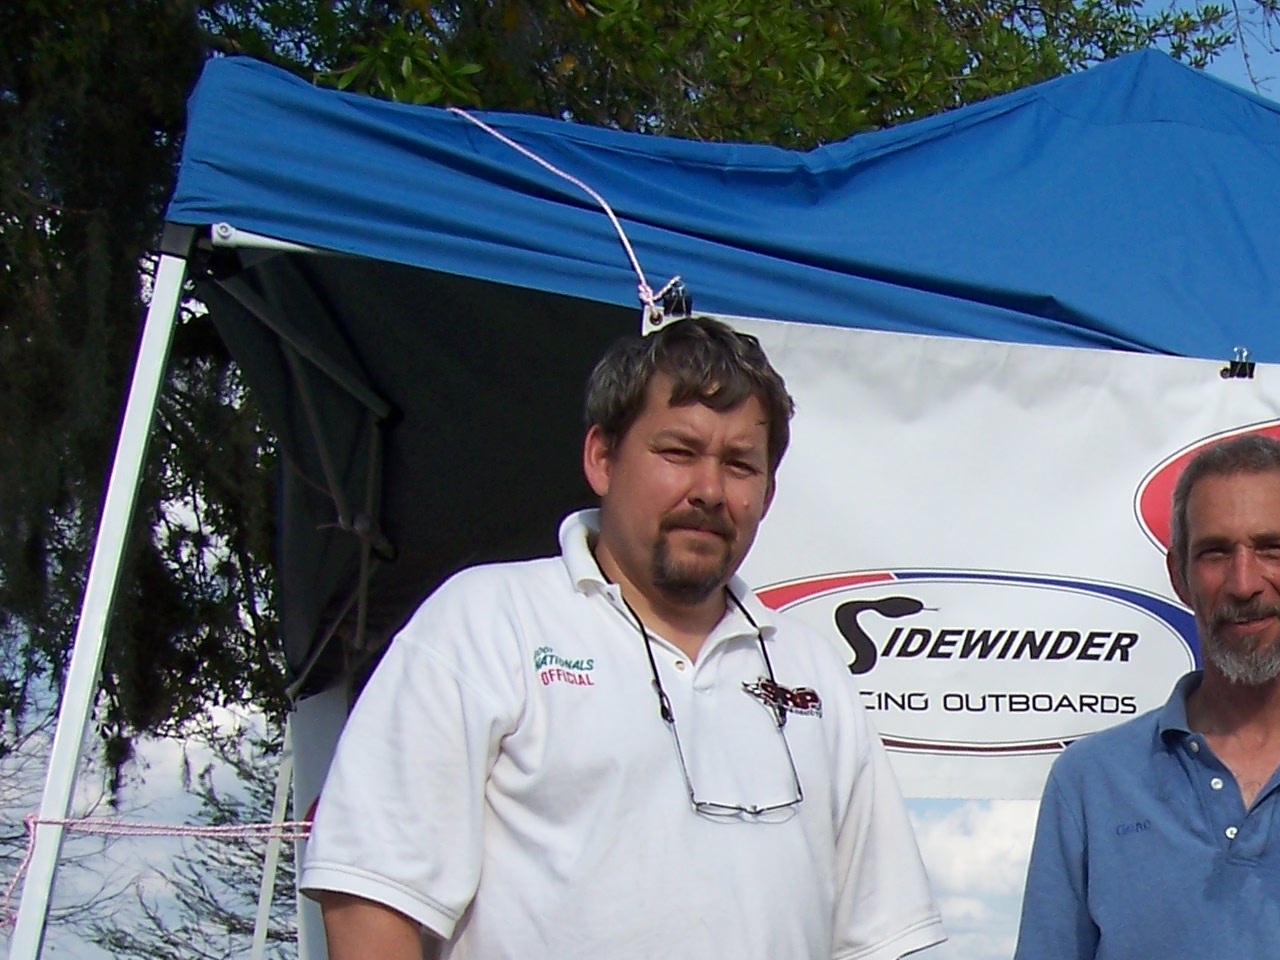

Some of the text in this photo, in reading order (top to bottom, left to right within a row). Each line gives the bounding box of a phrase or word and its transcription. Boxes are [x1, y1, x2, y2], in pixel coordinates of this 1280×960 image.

[834, 595, 1140, 675] SIDEWINDER
[535, 654, 594, 671] NATIONALS
[541, 668, 595, 686] OFFICIAL
[943, 693, 1137, 714] OUTBOARDS
